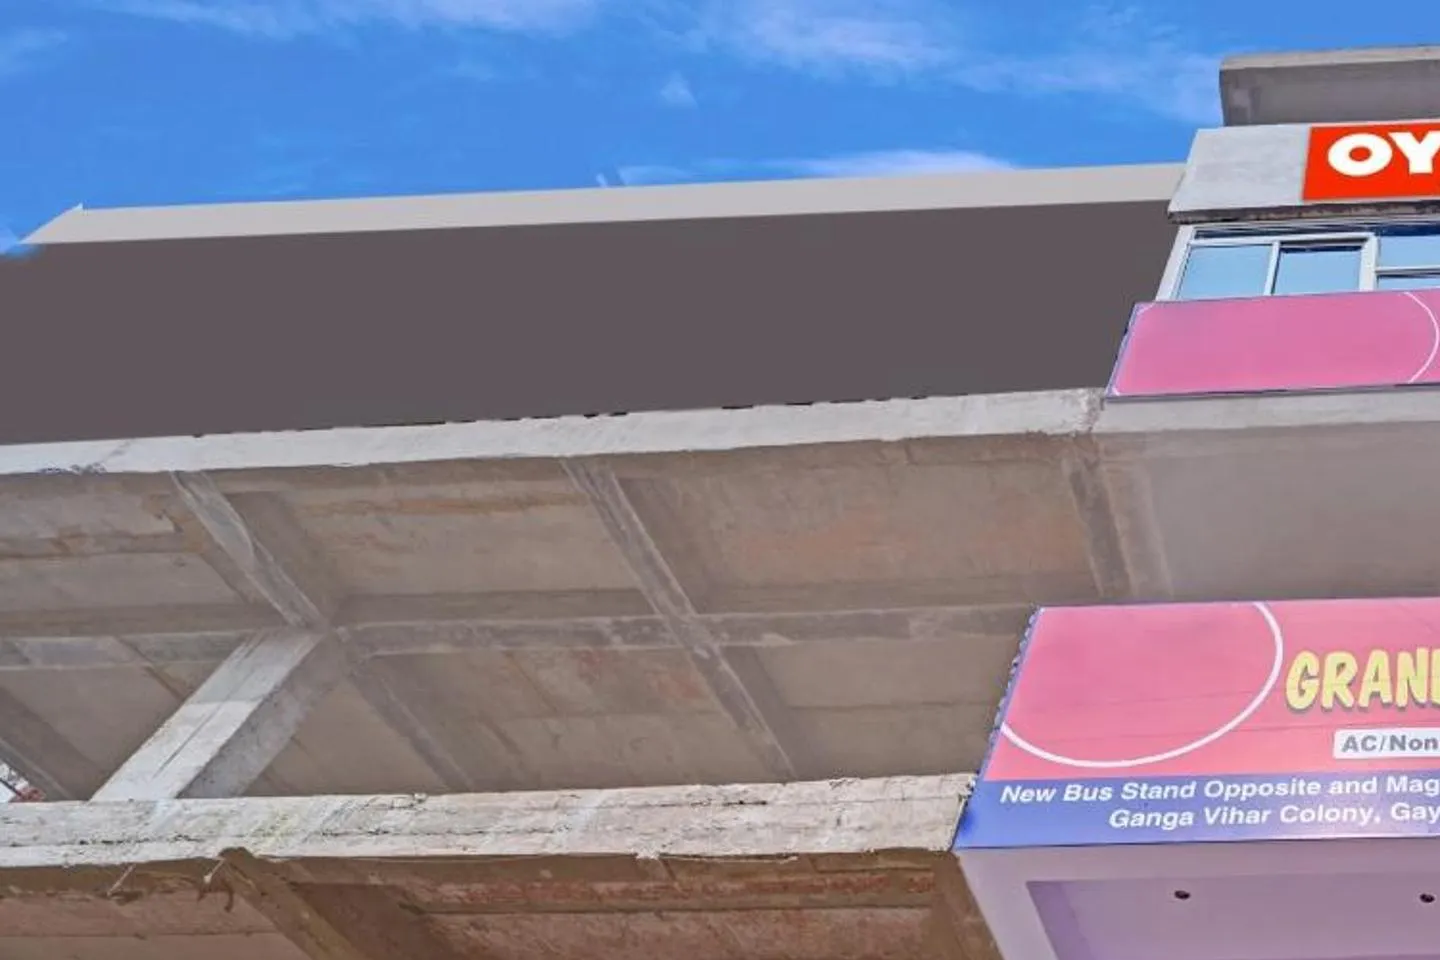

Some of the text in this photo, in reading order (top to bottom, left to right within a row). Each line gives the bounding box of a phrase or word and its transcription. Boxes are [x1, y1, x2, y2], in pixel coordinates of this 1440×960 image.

[1342, 734, 1439, 752] AC/Non
[1000, 784, 1054, 804] New
[1063, 783, 1113, 802] Bus
[1120, 781, 1197, 801] Stand
[1203, 779, 1322, 802] Opposite
[1327, 776, 1378, 794] and
[1108, 808, 1194, 831] Ganga
[1204, 806, 1271, 826] Vihar
[1280, 803, 1382, 827] Colony,
